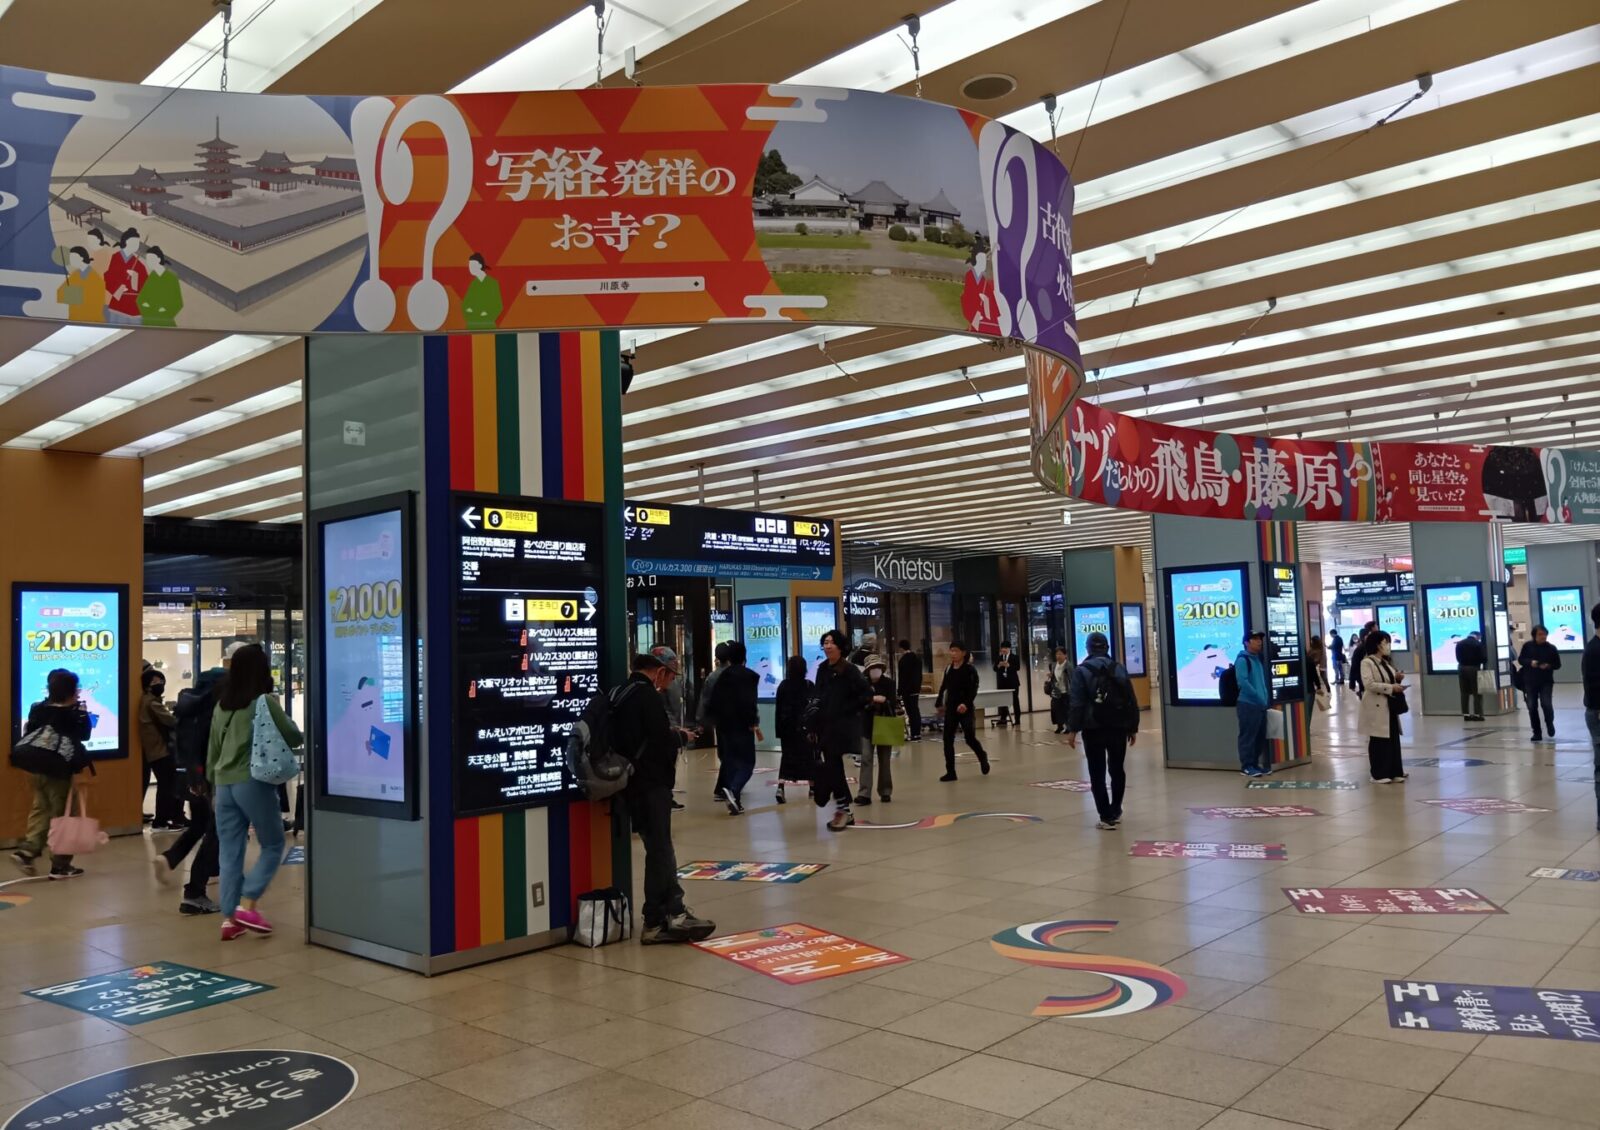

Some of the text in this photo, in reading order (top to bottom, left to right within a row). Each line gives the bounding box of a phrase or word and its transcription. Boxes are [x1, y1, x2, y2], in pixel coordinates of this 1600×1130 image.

[485, 147, 736, 202] 写経発祥の
[551, 211, 681, 252] お寺?
[600, 281, 630, 291] 川原寺
[1414, 452, 1461, 468] あなたと
[1408, 469, 1469, 485] 同じ星空を
[1415, 486, 1466, 502] 見ていた?
[799, 539, 830, 548] バス・タクシー
[462, 561, 479, 571] 交番
[336, 579, 403, 623] 21,000
[1183, 601, 1240, 621] 21,000
[528, 628, 597, 637] あべのハルカス美術館
[35, 629, 115, 653] 21,000
[477, 676, 557, 688] 大阪マリオット都ホテル
[571, 674, 598, 683] オフィス
[478, 725, 545, 739] きんえいアポロビル
[551, 722, 574, 733] あべの
[468, 750, 537, 766] 天王寺公園・動物園
[1453, 989, 1501, 1032] 教科書で
[1510, 1014, 1549, 1035] 見た
[24, 1055, 292, 1130] Commuter Passes
[120, 1081, 240, 1113] Tickets
